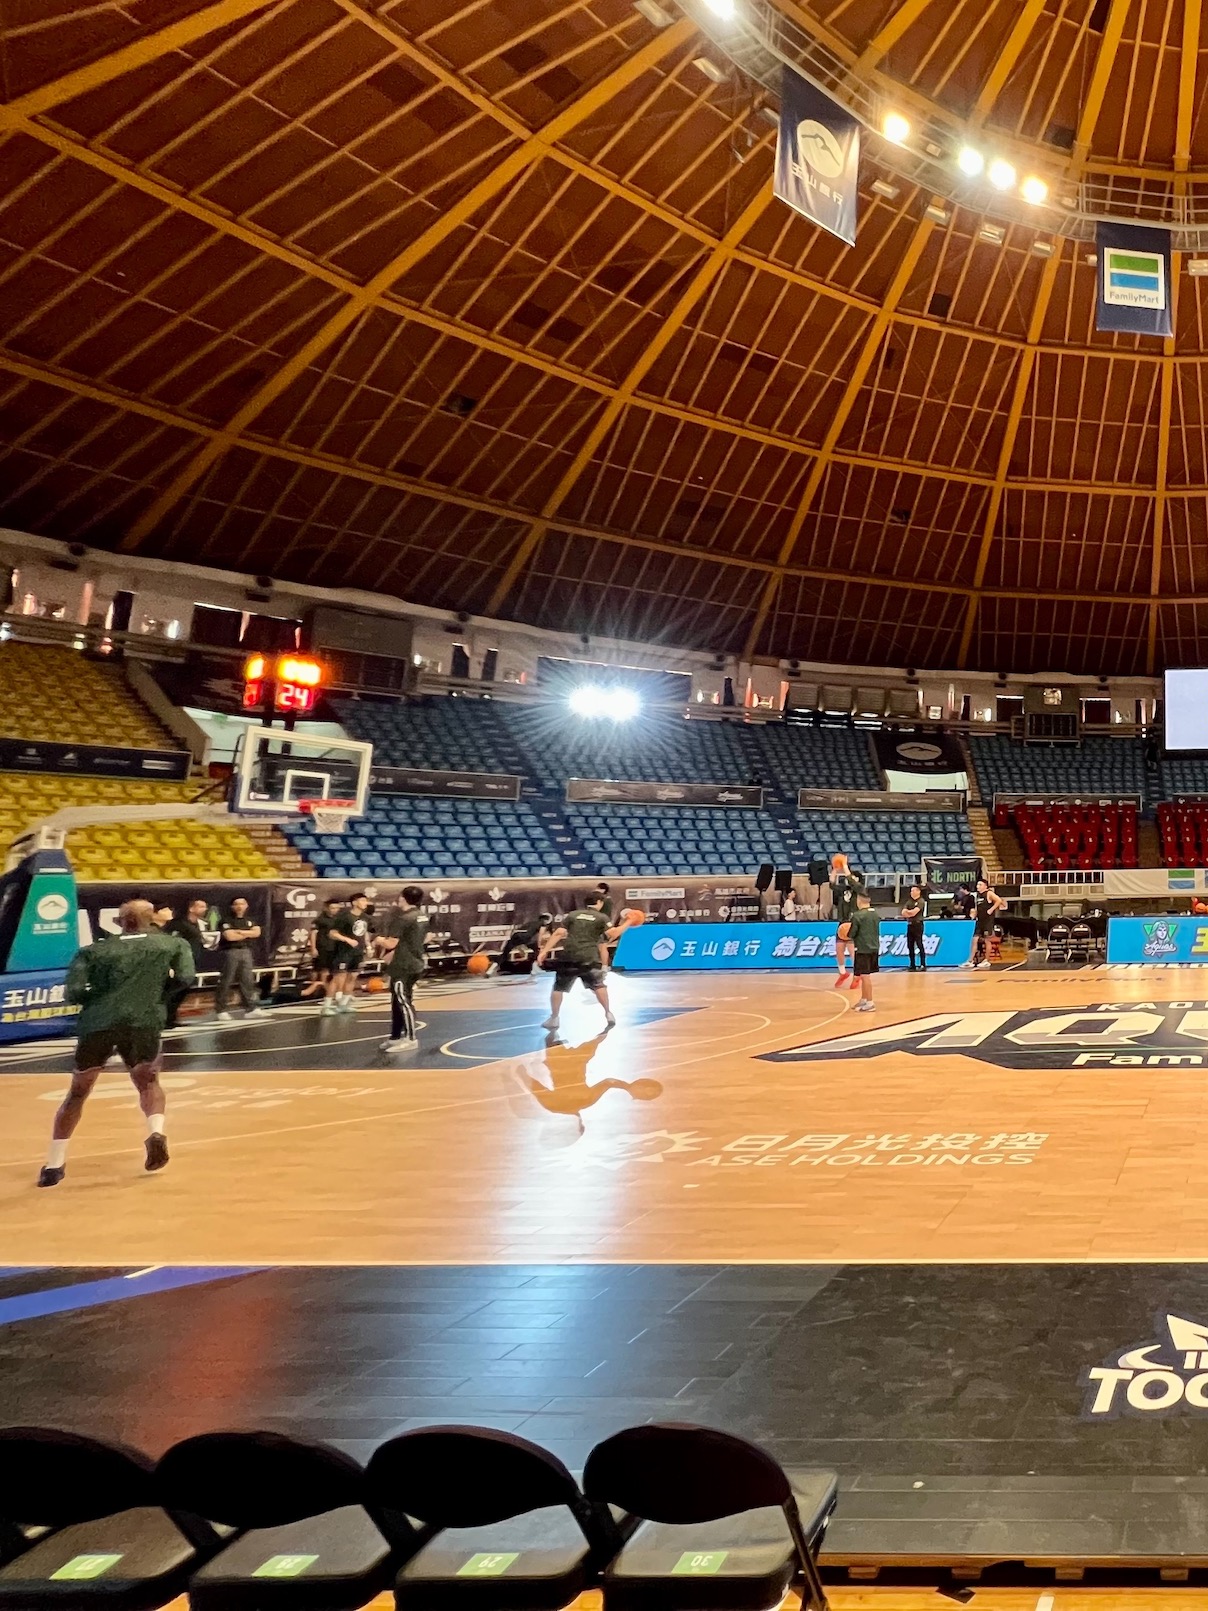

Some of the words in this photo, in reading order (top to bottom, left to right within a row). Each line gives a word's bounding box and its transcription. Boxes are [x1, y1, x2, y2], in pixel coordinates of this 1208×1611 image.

[1109, 291, 1160, 304] FamilyMart
[280, 684, 310, 706] 24
[931, 870, 943, 883] 北
[946, 870, 976, 883] NORTH
[680, 940, 762, 957] 玉山銀行
[721, 1132, 1050, 1152] 日月光投控
[684, 1154, 788, 1167] ASE
[789, 1153, 1037, 1167] HOLDINGS
[690, 1555, 713, 1567] 30
